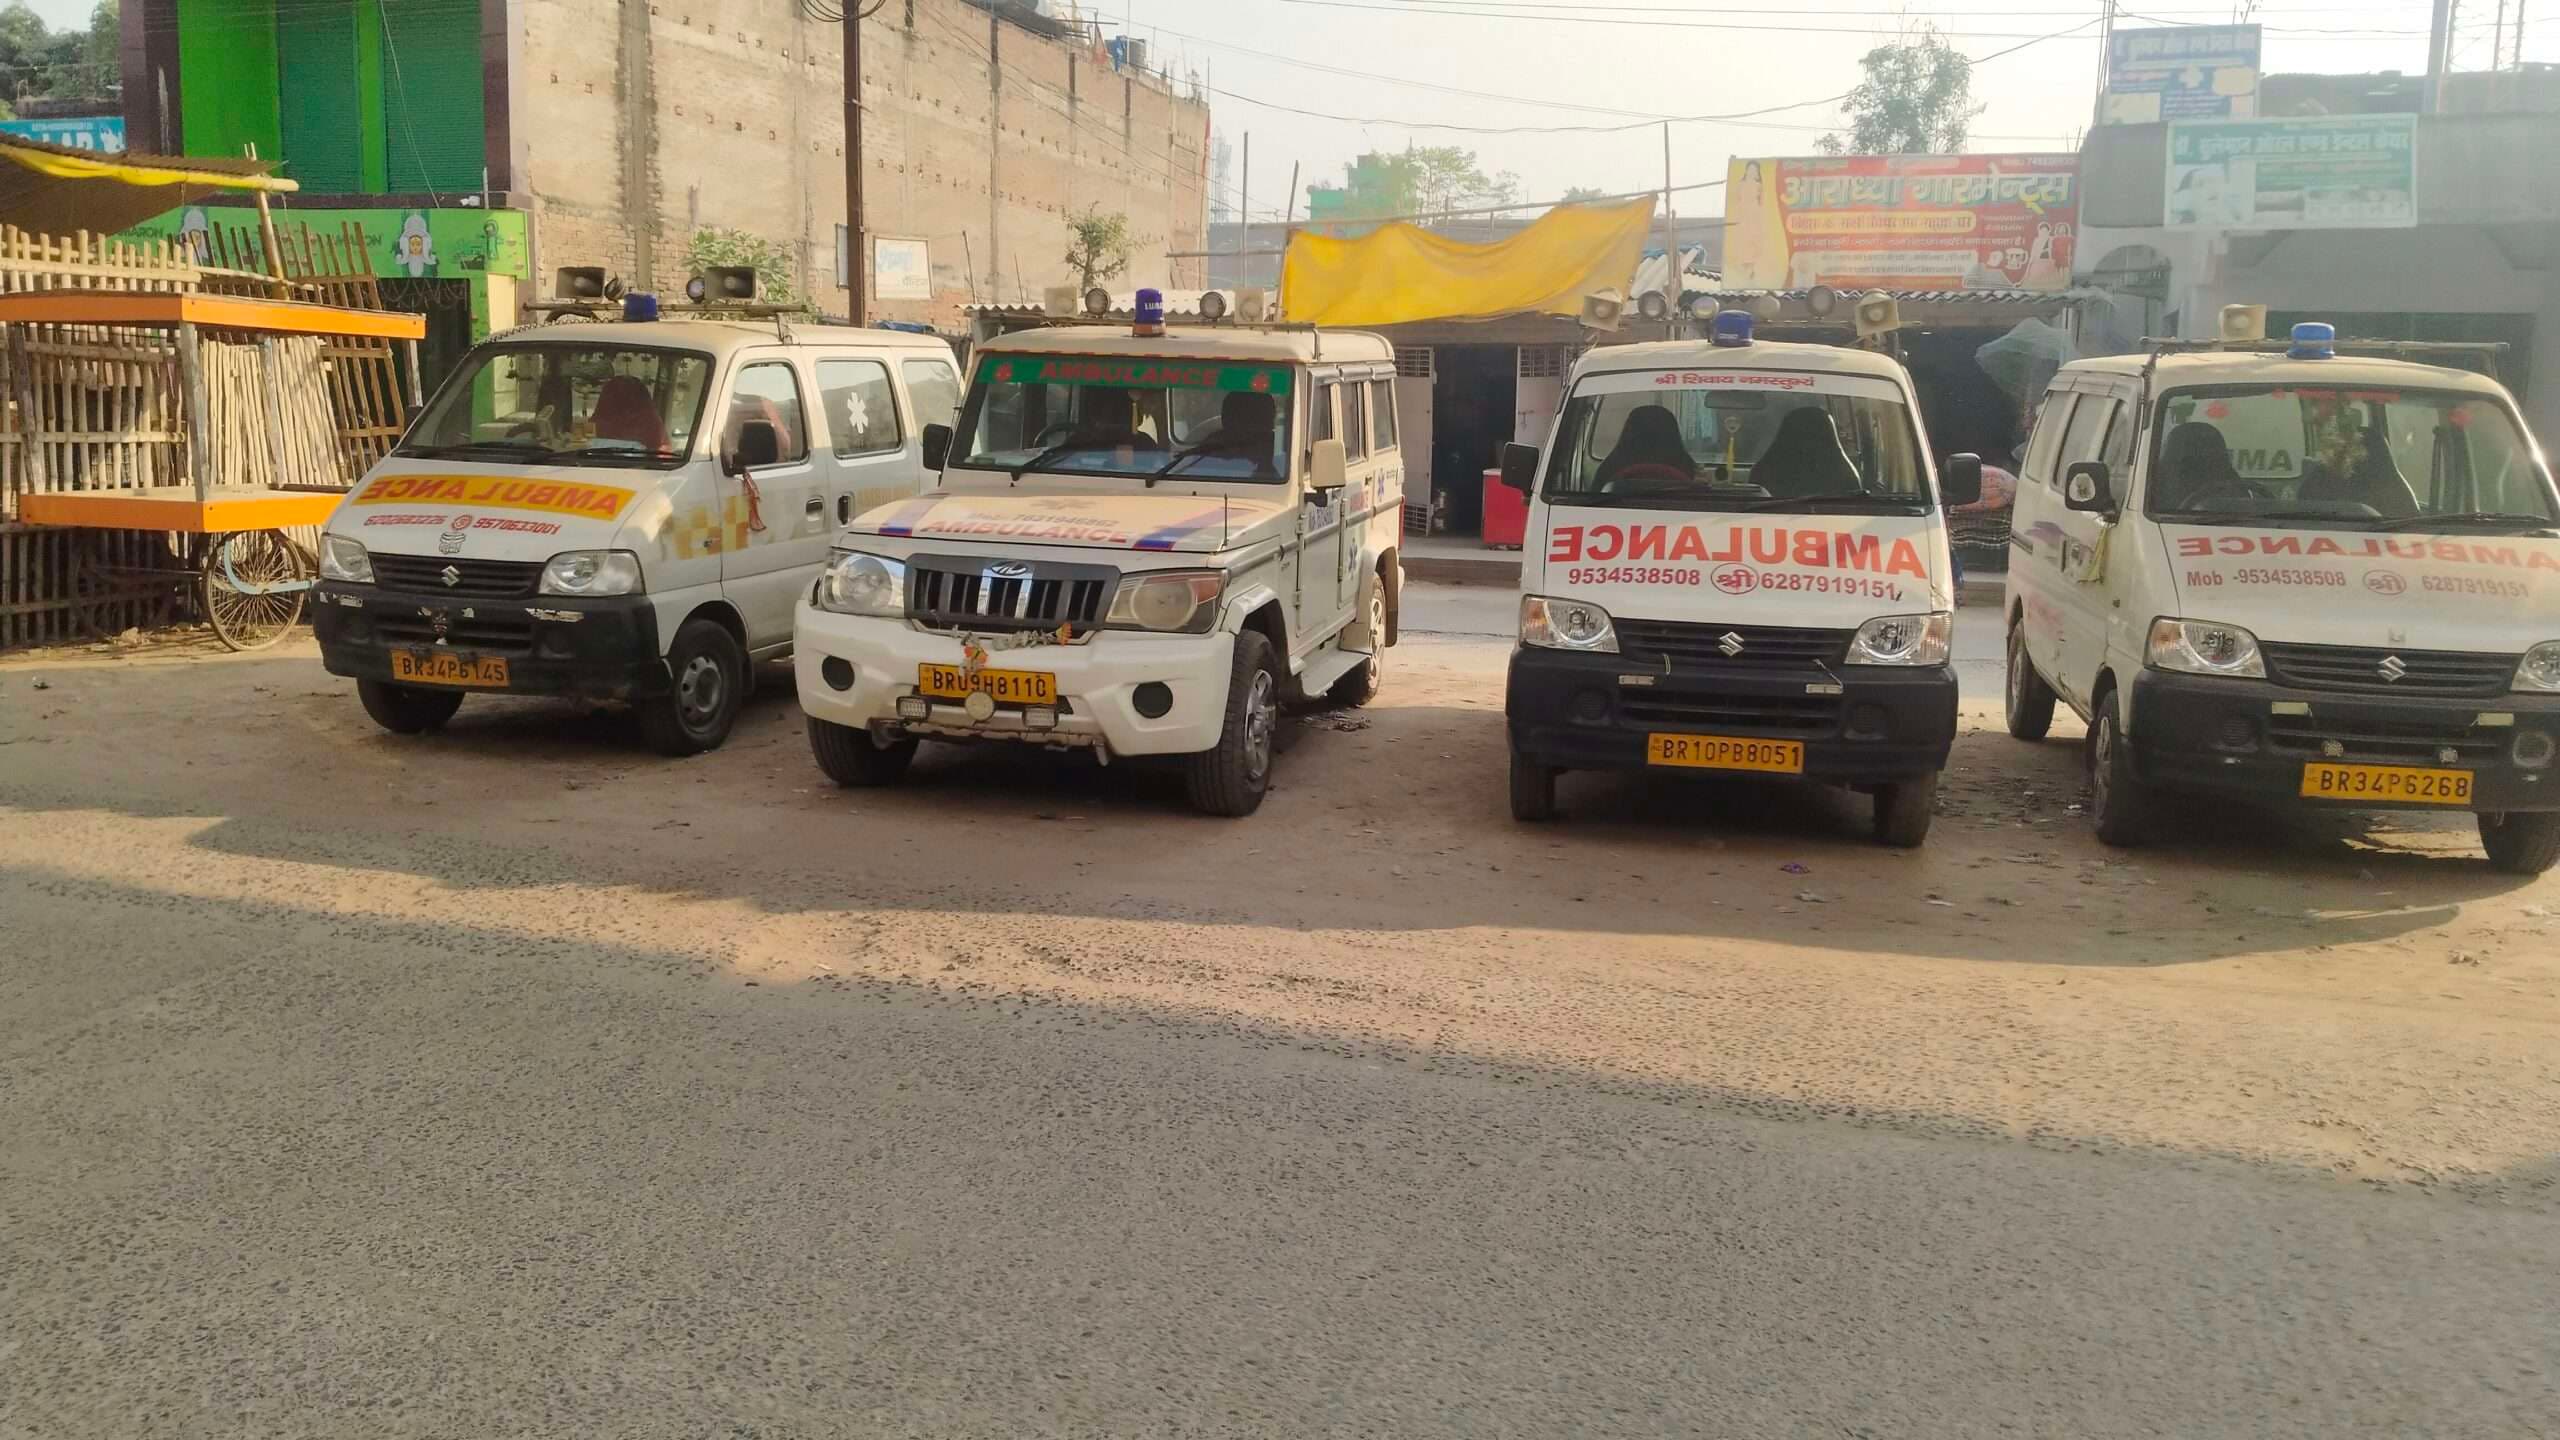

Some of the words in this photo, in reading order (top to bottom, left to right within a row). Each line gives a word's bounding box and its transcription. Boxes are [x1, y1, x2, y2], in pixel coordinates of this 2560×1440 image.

[1781, 175, 1903, 207] आराध्या
[1040, 362, 1219, 387] AMBULANCE
[1655, 373, 1676, 385] श्री
[1682, 372, 1735, 385] शिवाय
[920, 522, 1128, 544] AMBULANCE
[1568, 567, 1701, 586] 9534538508
[1761, 572, 1897, 601] 6287919151
[2187, 571, 2223, 586] Mob
[2422, 575, 2529, 598] 6287919151
[1663, 739, 1799, 767] BR10PB8051
[2320, 770, 2468, 797] BR34P6268
